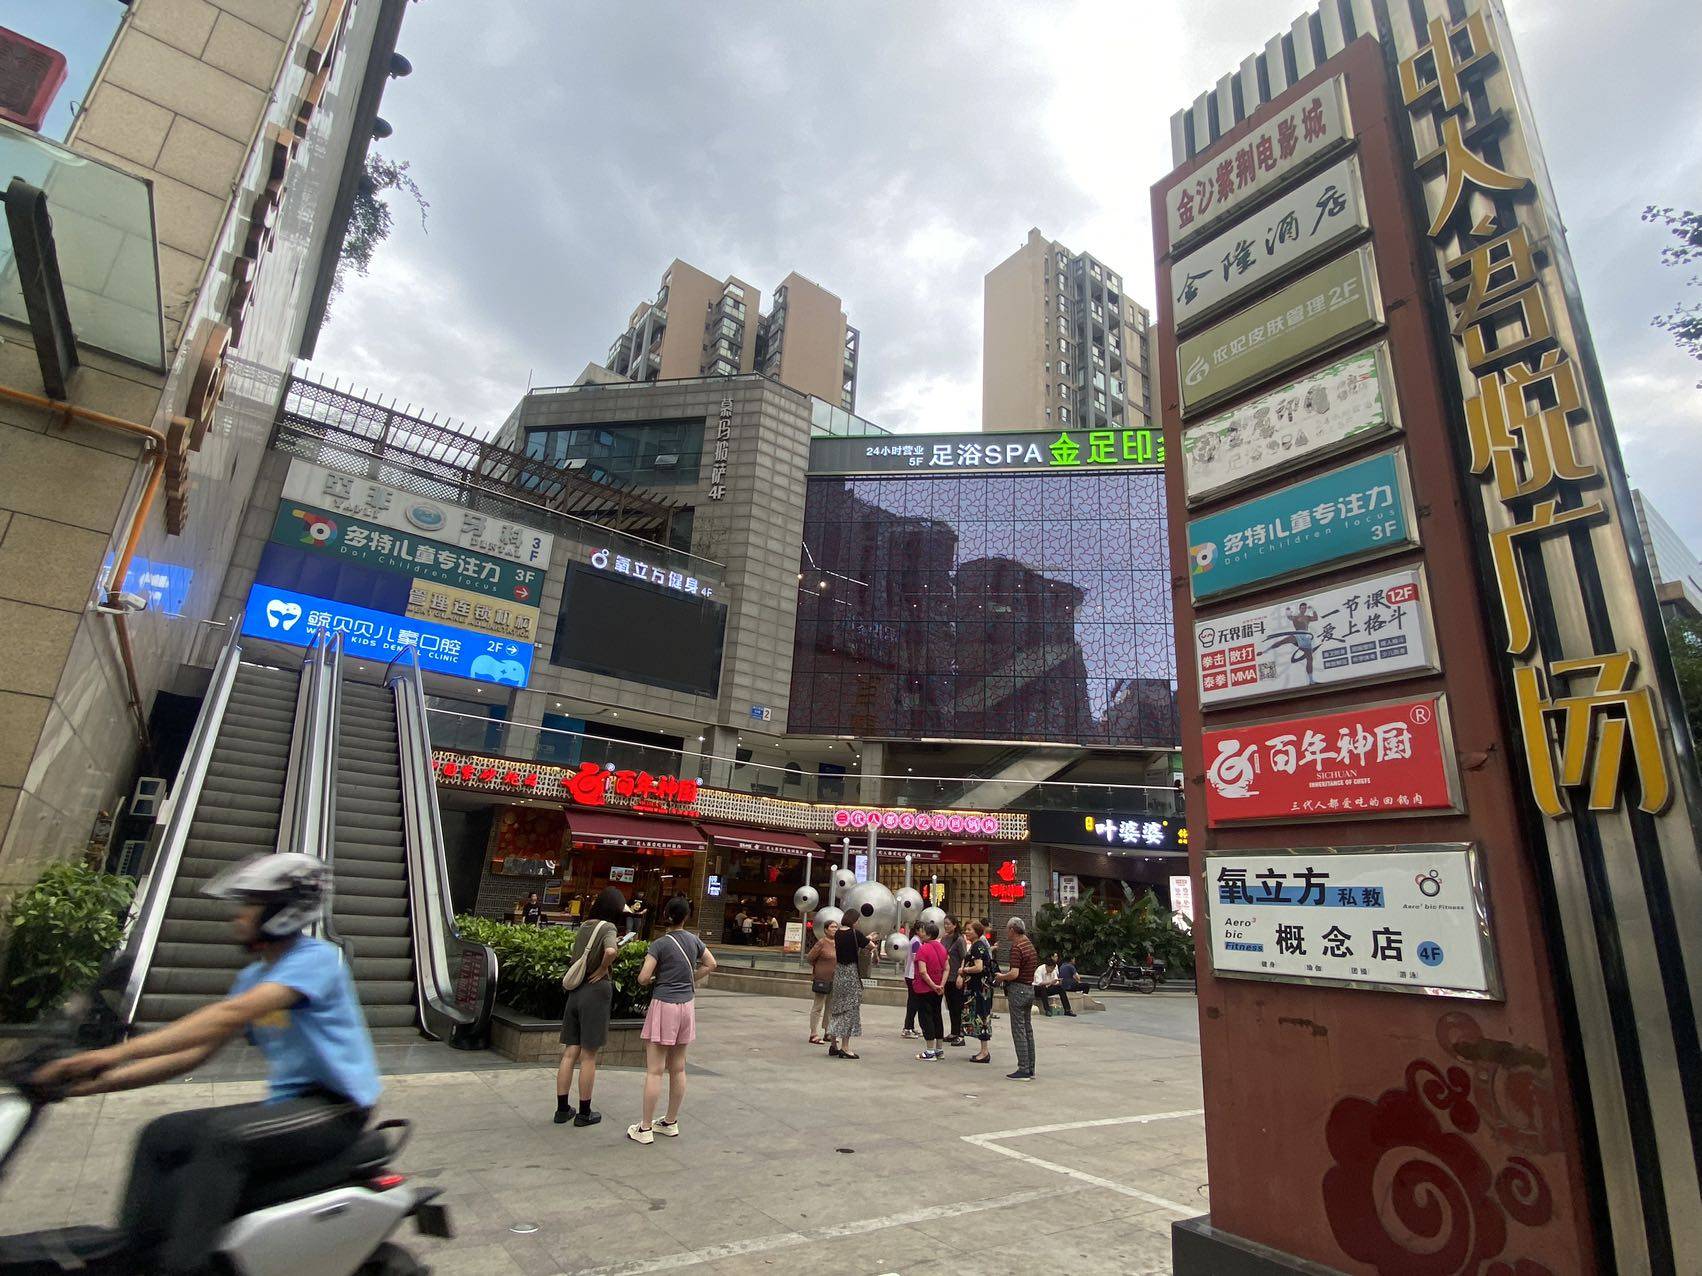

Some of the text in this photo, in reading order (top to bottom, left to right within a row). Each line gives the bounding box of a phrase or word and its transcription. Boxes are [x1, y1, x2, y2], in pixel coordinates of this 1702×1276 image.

[1177, 98, 1326, 229] 金沙紫荆电影城
[866, 445, 924, 457] 24小时营业
[909, 457, 924, 467] 5F
[928, 443, 1044, 467] 足浴SPA
[1223, 484, 1393, 555] 多特儿童专注力
[1371, 520, 1397, 541] 3F
[1259, 528, 1333, 555] Children
[1345, 510, 1395, 529] focus
[344, 526, 501, 583] 多特儿童专注力
[378, 555, 447, 580] Children
[458, 576, 498, 592] focus
[515, 569, 536, 583] 3F
[614, 554, 699, 595] 氧立方健身
[409, 587, 533, 630] 管理连锁机构
[1321, 589, 1391, 619] 一节课
[307, 609, 462, 656] 鲸贝贝儿童口腔
[1218, 621, 1266, 644] 无界格斗
[1317, 606, 1407, 643] 爱上格斗
[351, 636, 459, 663] KIDS DENL CLINIC
[486, 640, 504, 653] 2F
[1229, 647, 1254, 663] 散打
[1202, 653, 1225, 668] 拳击
[1203, 673, 1228, 689] 泰拳
[1231, 669, 1257, 683] MMA
[1265, 721, 1412, 774] 百年神厨
[1316, 769, 1358, 780] SICHUAN
[1290, 793, 1424, 812] 三代人都爱吃的回锅肉
[1095, 818, 1165, 845] 叶婆婆
[1217, 866, 1330, 906] 氧立方
[1337, 888, 1382, 907] 私教
[1225, 929, 1243, 939] bic
[1225, 941, 1264, 952] Fitness
[1275, 923, 1441, 961] 概念店 4F
